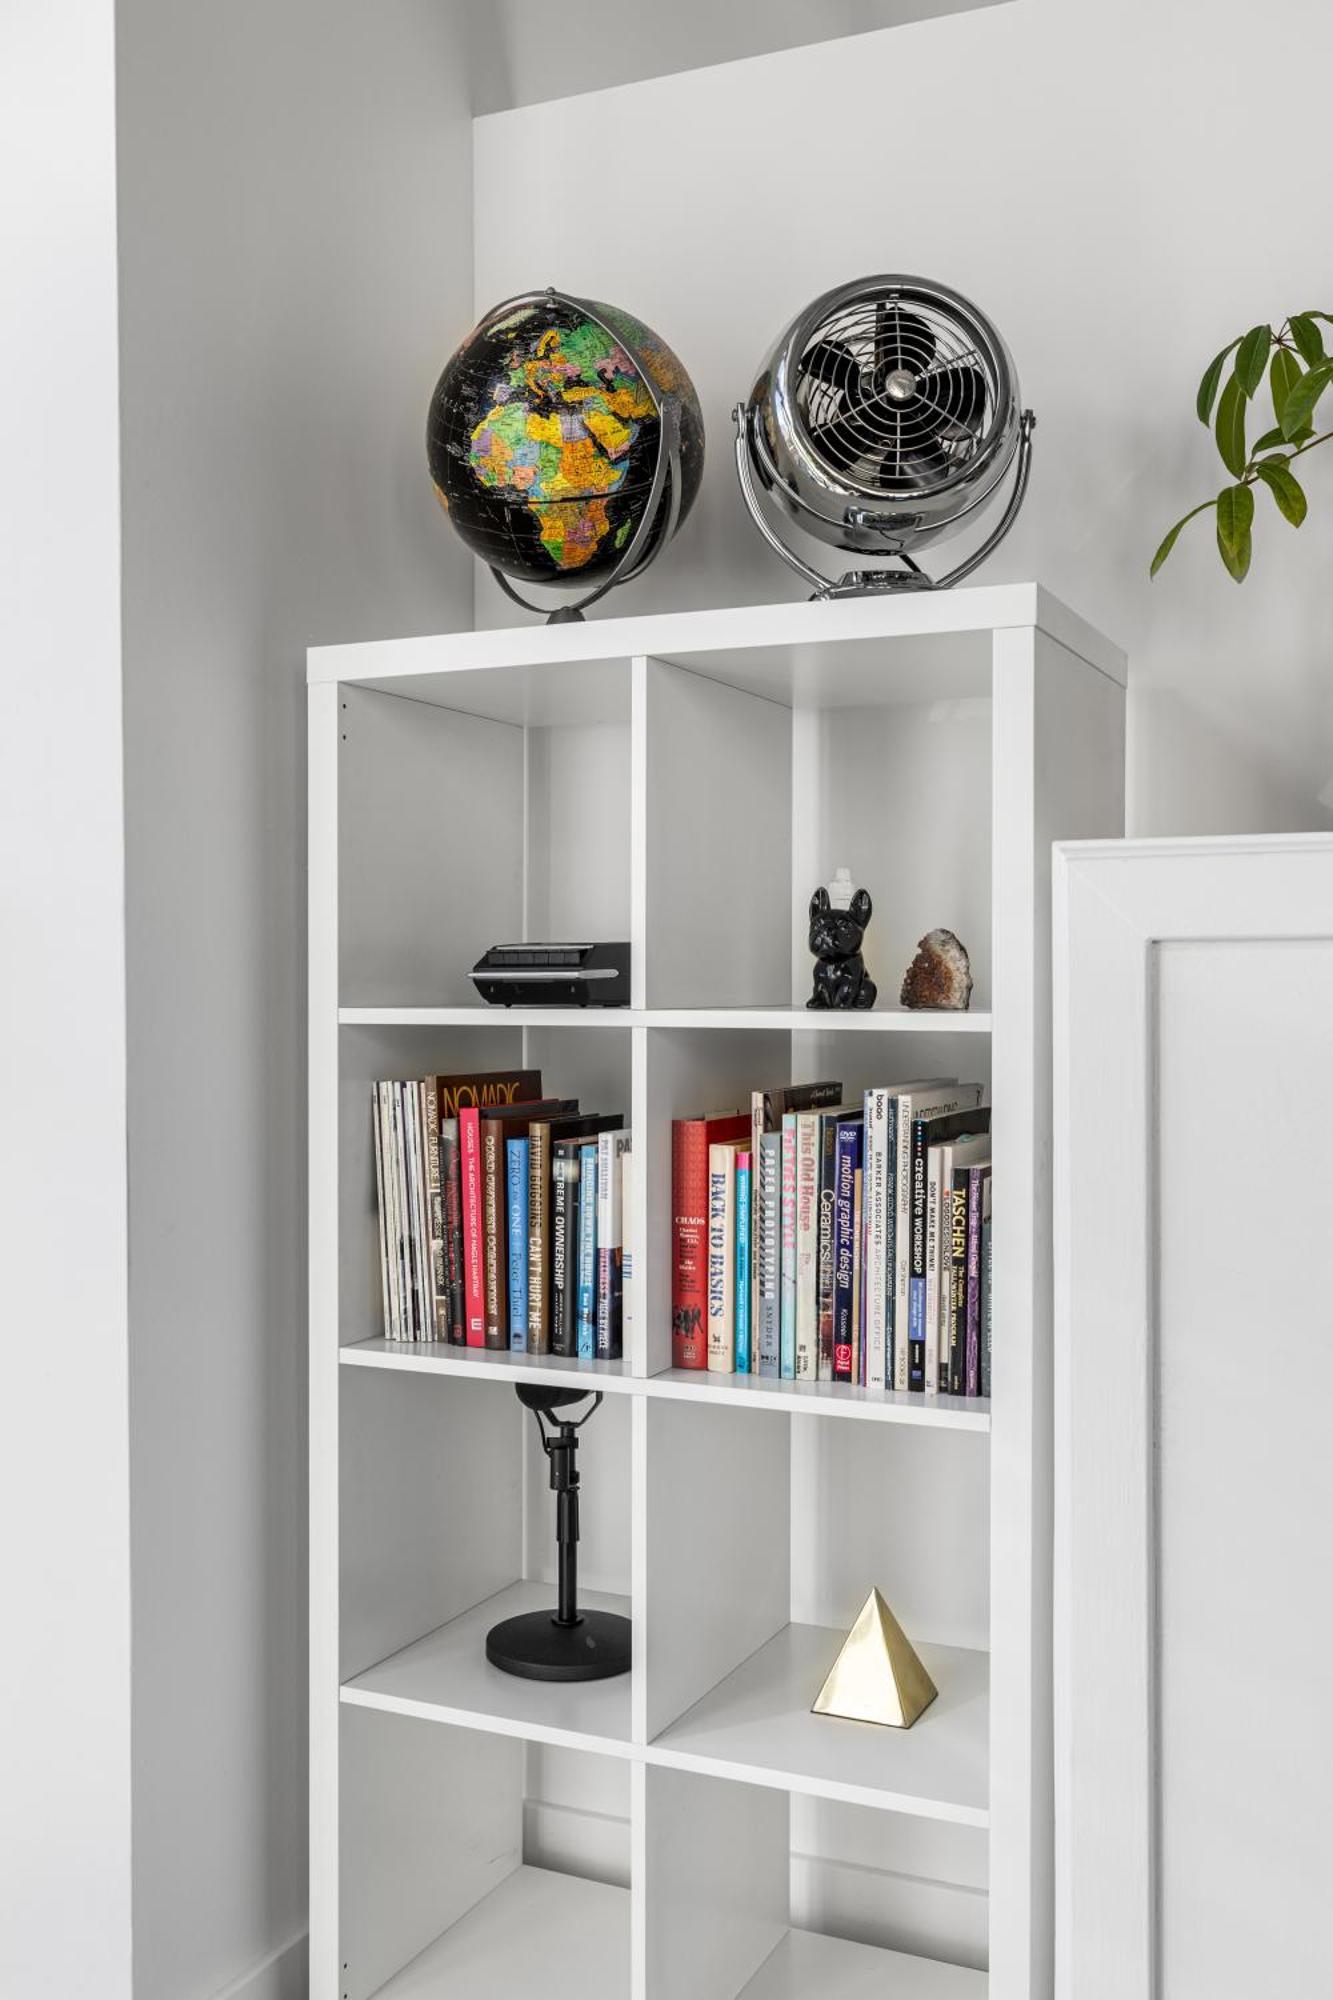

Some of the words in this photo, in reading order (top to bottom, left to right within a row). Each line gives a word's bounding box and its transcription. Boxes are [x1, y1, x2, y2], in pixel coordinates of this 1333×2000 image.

[427, 1091, 438, 1133] NOMADIC
[444, 1082, 520, 1118] NOMADIC
[466, 1122, 475, 1154] HOUSES
[800, 1121, 815, 1155] This
[839, 1130, 857, 1138] DVD
[900, 1100, 910, 1160] UNDERSTANDING
[430, 1136, 440, 1181] FURNITURE
[468, 1158, 476, 1172] THE
[510, 1149, 521, 1186] ZERO
[529, 1134, 542, 1170] DAVID
[783, 1128, 797, 1193] FIFTIES
[800, 1156, 815, 1183] Old
[874, 1151, 883, 1188] BARKER
[764, 1149, 776, 1193] PAPER
[841, 1155, 854, 1197] motion
[900, 1160, 909, 1214] PHOTOGRAPHY
[914, 1158, 926, 1216] creative
[468, 1172, 478, 1227] ARCHITECTURE
[529, 1174, 542, 1228] GOGGINS
[710, 1172, 726, 1220] BACK
[799, 1184, 815, 1232] House
[929, 1181, 937, 1206] DON'T
[470, 1228, 478, 1238] OF
[511, 1204, 521, 1237] ONE
[675, 1216, 705, 1225] CHAOS
[783, 1197, 796, 1249] STYLE
[820, 1189, 836, 1260] Ceramics
[838, 1200, 854, 1245] graphic
[874, 1190, 882, 1246] ASSOCIATES
[929, 1206, 937, 1230] MAKE
[952, 1188, 966, 1258] TASCHEN
[529, 1237, 542, 1273] CAN'T
[554, 1215, 566, 1290] OWNERSHIP
[710, 1225, 725, 1249] TO
[764, 1200, 776, 1299] PROTOTYPING
[913, 1217, 923, 1275] WORKSHOP
[928, 1231, 936, 1243] ME
[511, 1252, 522, 1282] Peter
[837, 1248, 853, 1289] design
[928, 1244, 936, 1272] THINK!
[529, 1275, 542, 1308] HURT
[710, 1253, 725, 1317] BASICS
[873, 1247, 882, 1316] ARCHITECTURE
[957, 1279, 965, 1307] Complete
[511, 1287, 522, 1319] Thiel
[529, 1310, 541, 1330] ME
[765, 1306, 773, 1347] SNYDER
[840, 1308, 849, 1337] Krasner
[873, 1319, 881, 1351] OFFICE
